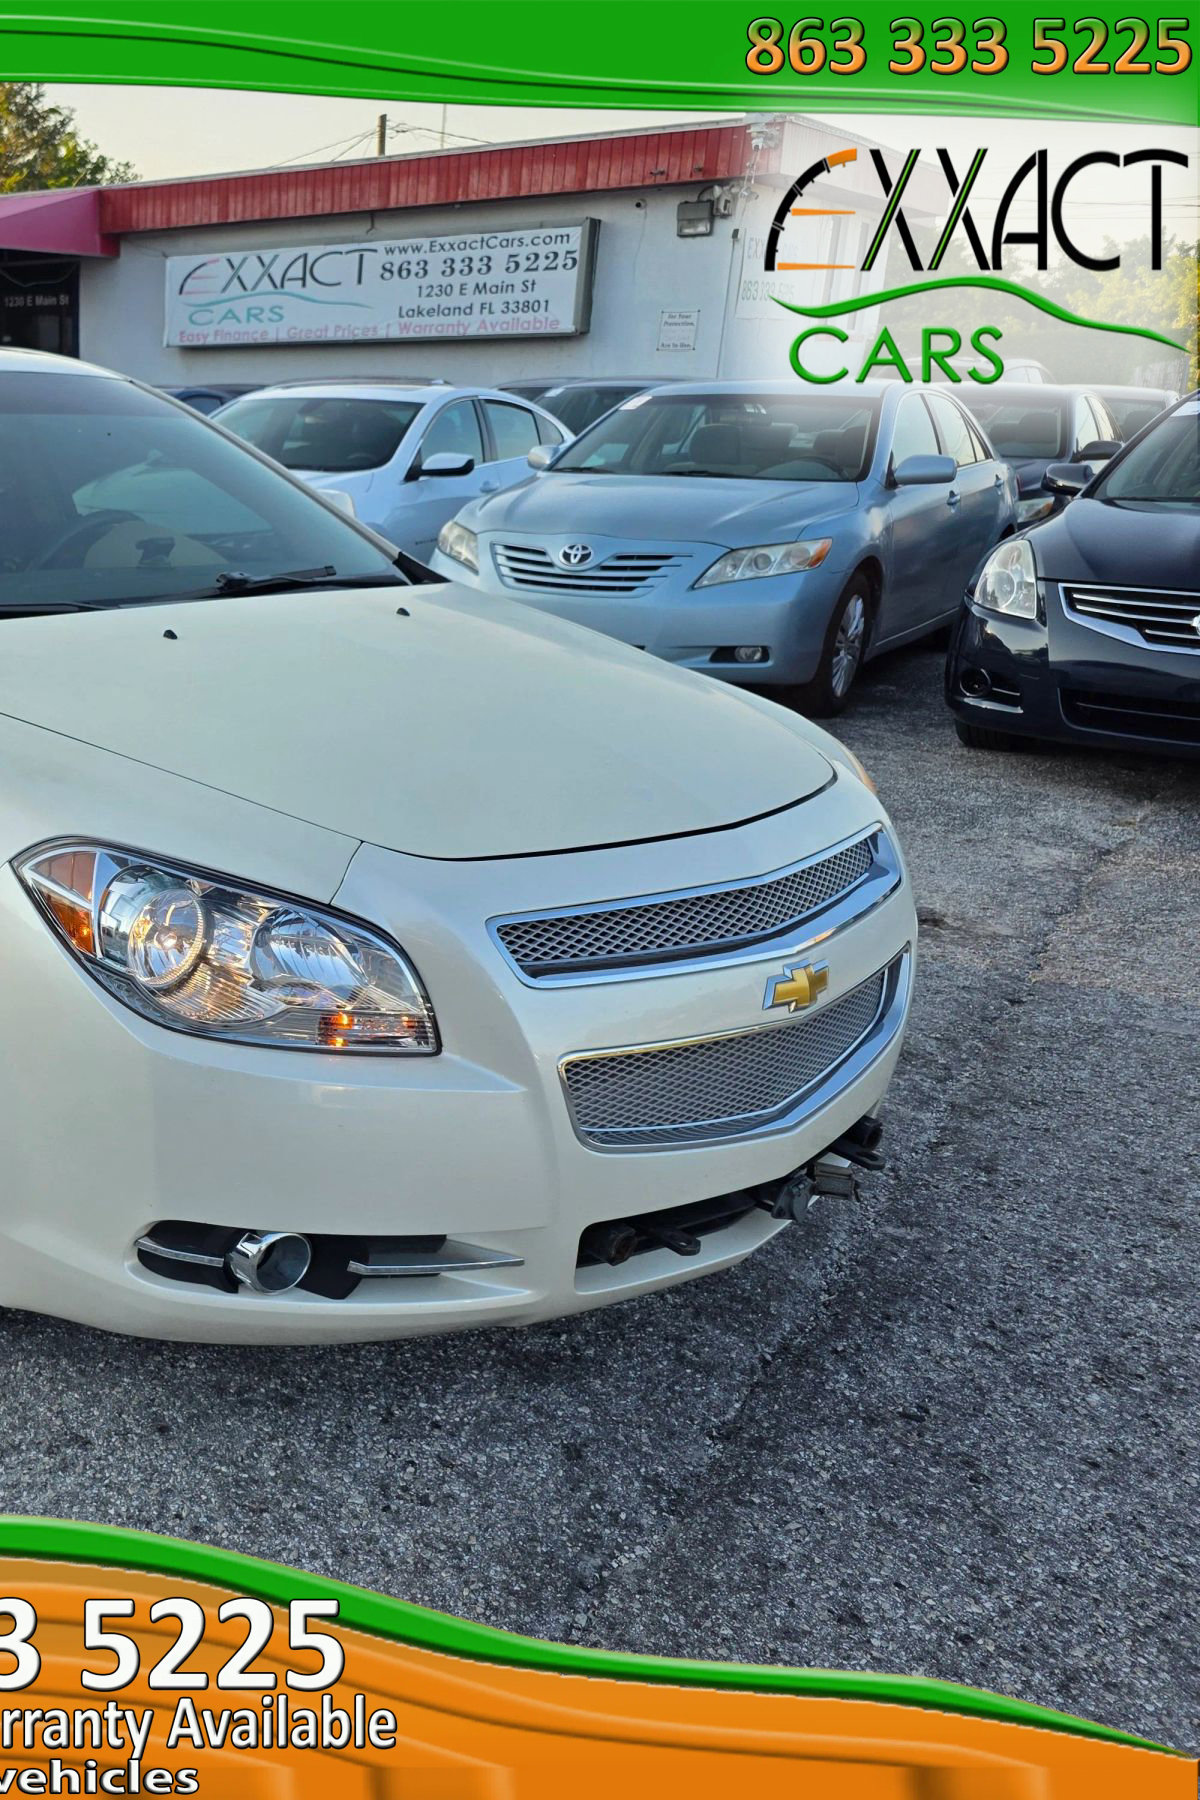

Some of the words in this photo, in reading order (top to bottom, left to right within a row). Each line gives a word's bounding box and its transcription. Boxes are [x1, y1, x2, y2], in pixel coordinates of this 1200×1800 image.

[384, 234, 570, 256] www.ExxactCars.com
[179, 248, 378, 296] EXXACT
[380, 260, 429, 281] 863
[441, 255, 492, 277] 333
[505, 250, 578, 273] 5225
[417, 284, 453, 298] 1230
[459, 283, 468, 296] E
[473, 281, 514, 295] Main
[521, 279, 536, 293] St
[26, 296, 33, 307] E
[398, 303, 473, 318] Lakeland
[480, 302, 495, 315] FL
[501, 300, 550, 314] 33801
[188, 305, 285, 326] CARS
[179, 330, 209, 344] Easy
[214, 328, 269, 342] Finance
[287, 325, 329, 339] Great
[334, 323, 379, 337] Prices
[399, 320, 470, 336] Warranty
[477, 317, 561, 332] Available
